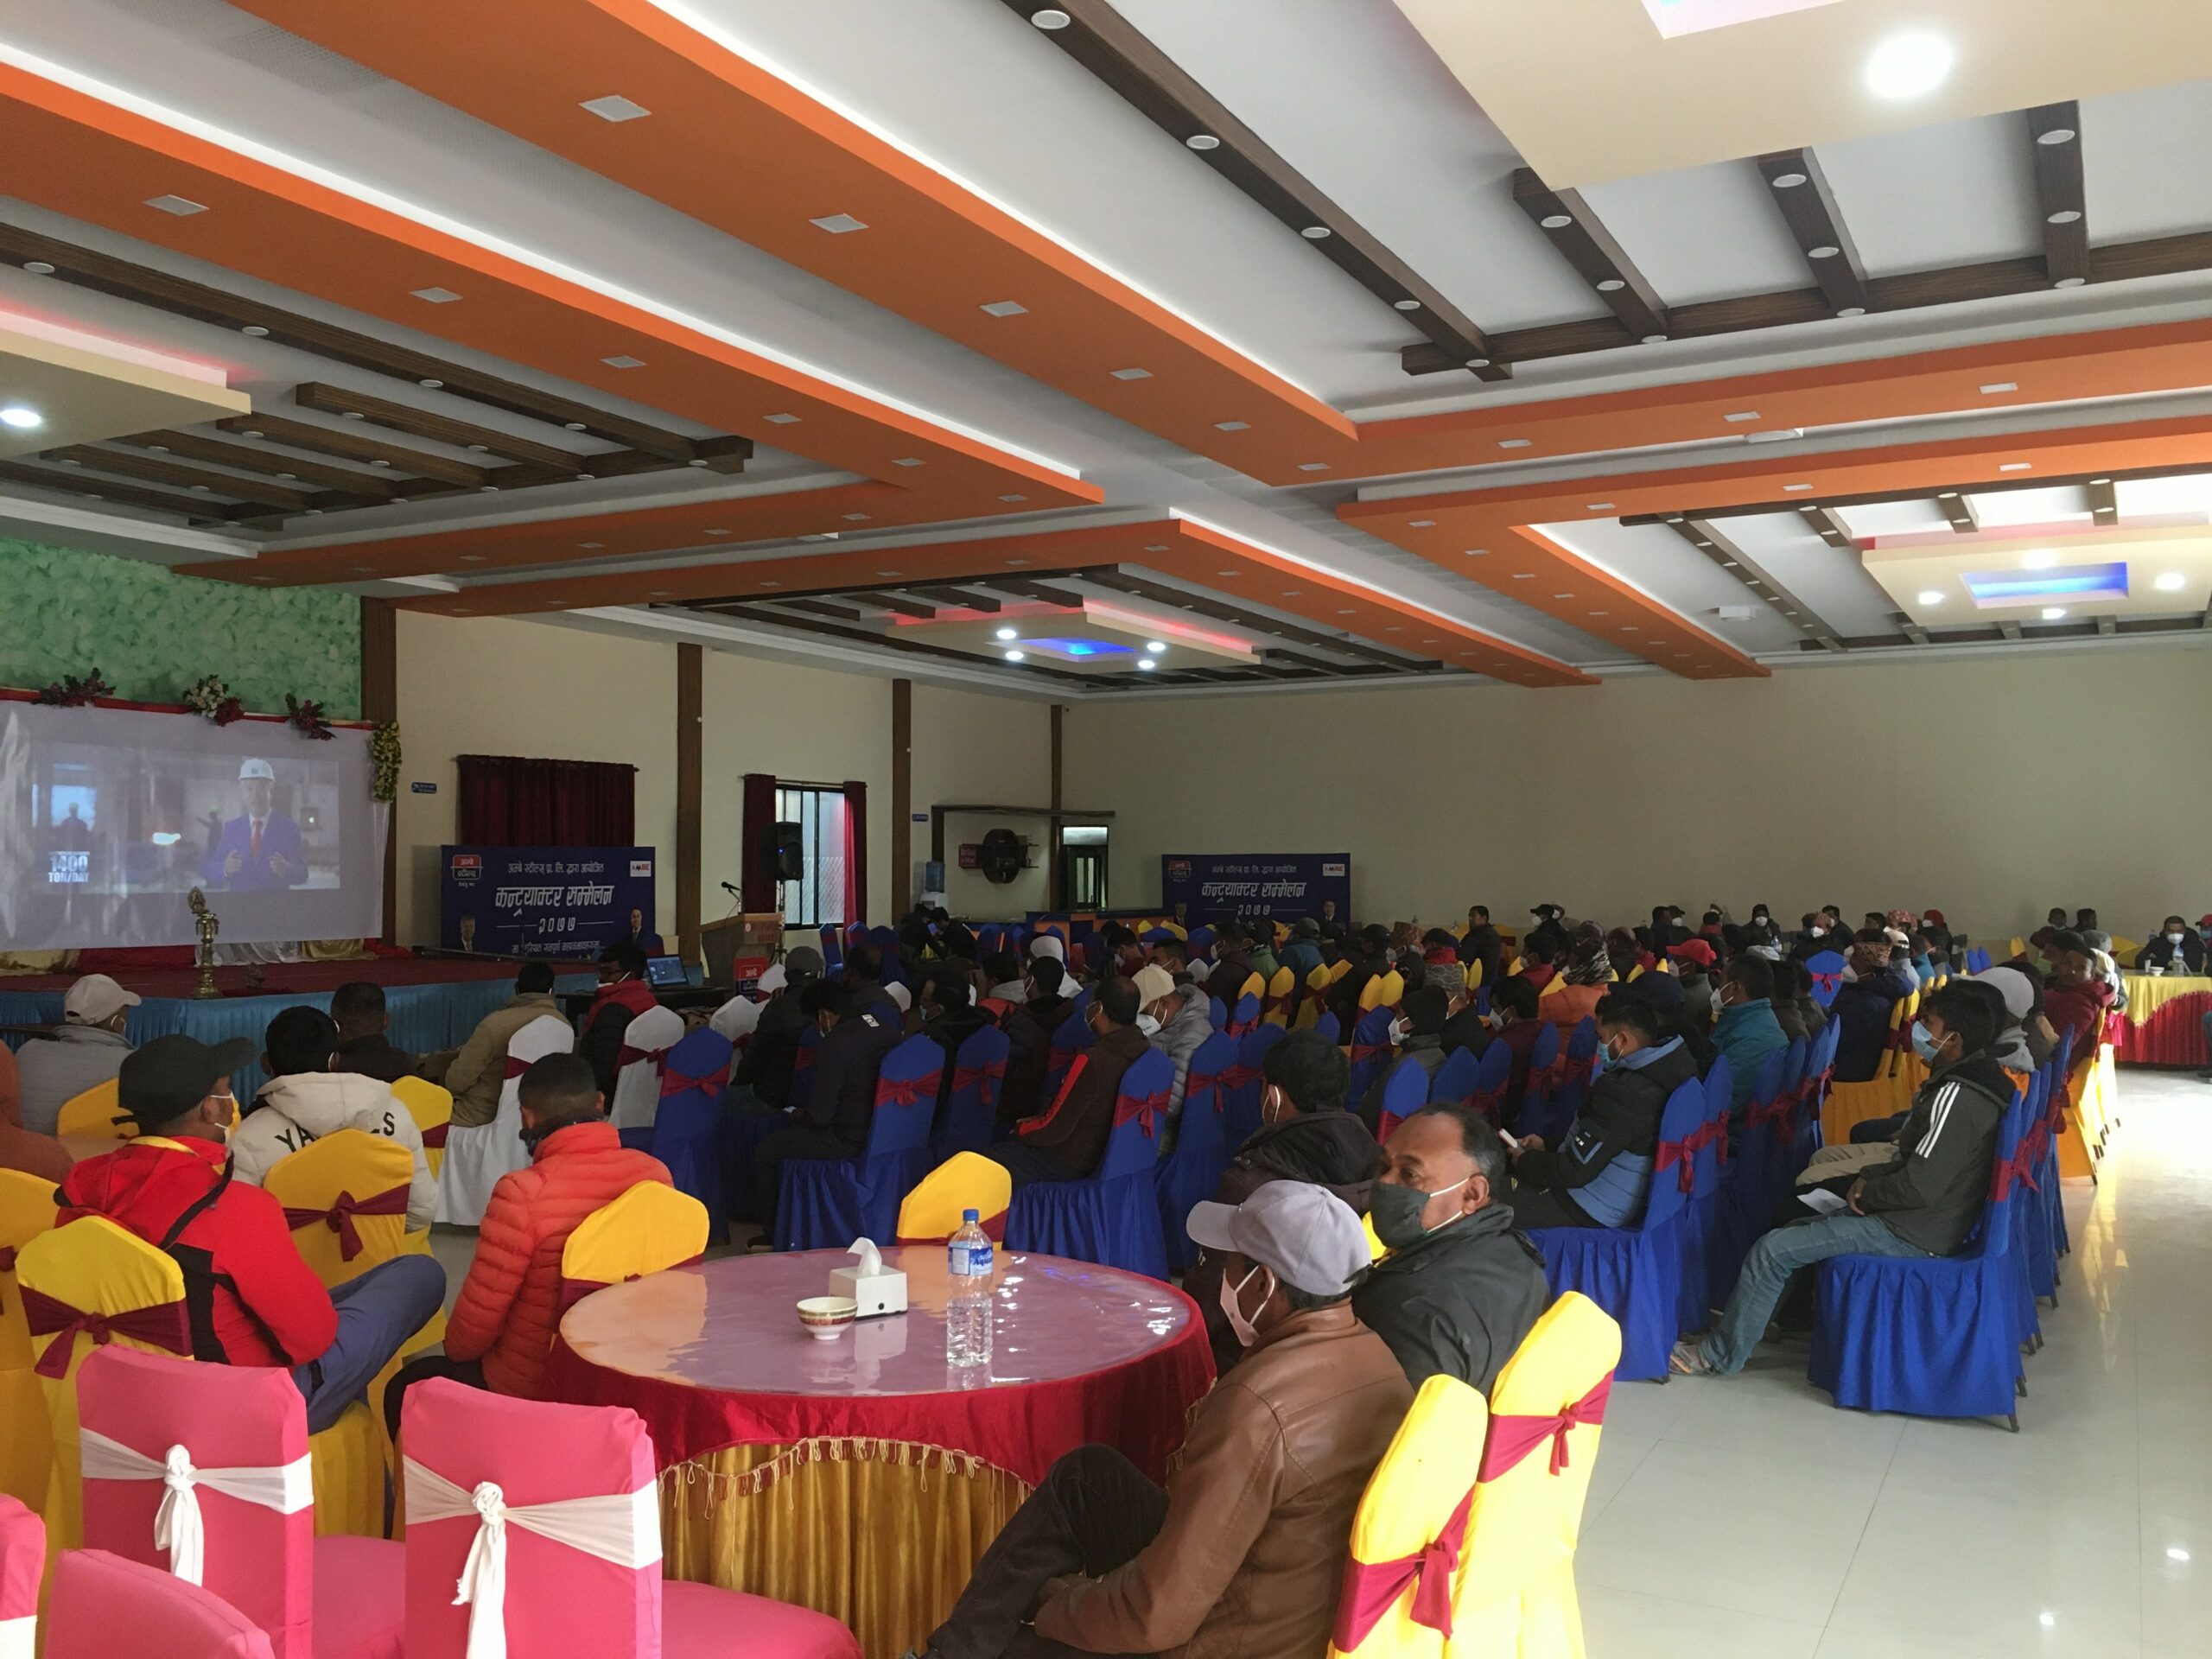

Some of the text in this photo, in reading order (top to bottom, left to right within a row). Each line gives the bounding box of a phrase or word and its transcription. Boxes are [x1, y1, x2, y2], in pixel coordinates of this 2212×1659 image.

[50, 855, 88, 872] 1400
[48, 872, 90, 883] TON/DAY
[566, 880, 615, 906] सम्मेलन
[1261, 878, 1307, 899] सम्मेलन
[1237, 904, 1271, 916] २०७७
[538, 917, 577, 935] २०७७
